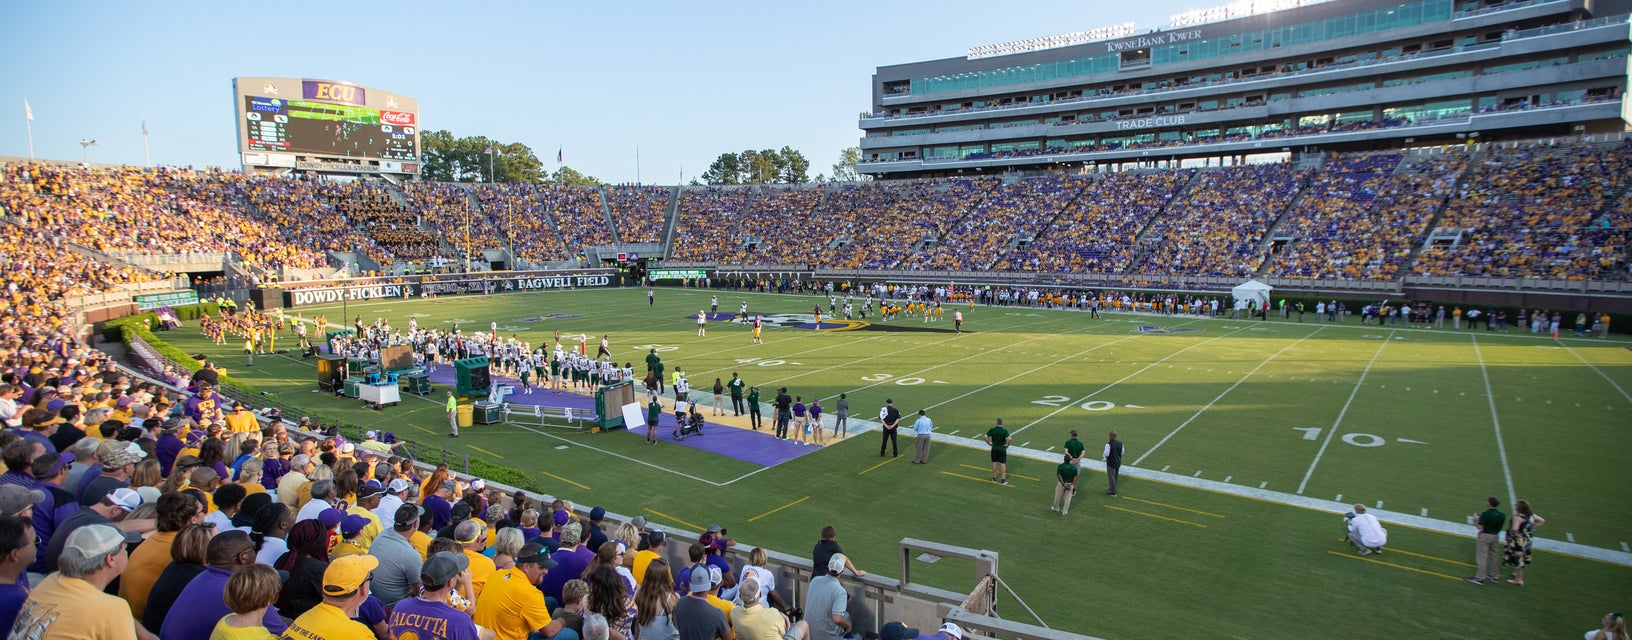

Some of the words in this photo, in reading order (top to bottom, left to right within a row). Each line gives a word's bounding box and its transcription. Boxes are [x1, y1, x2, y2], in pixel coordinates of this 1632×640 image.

[315, 83, 356, 102] ECU
[252, 104, 280, 113] Lottery
[1116, 118, 1152, 130] TRADE
[1155, 115, 1185, 127] CLUB
[354, 164, 379, 172] STADIUM
[577, 276, 610, 287] FIELD
[295, 285, 401, 305] DOWDY-FICKLEN
[860, 373, 927, 386] 30
[1030, 395, 1117, 412] 20
[1292, 426, 1387, 448] 10
[389, 611, 448, 638] CALCUTTA
